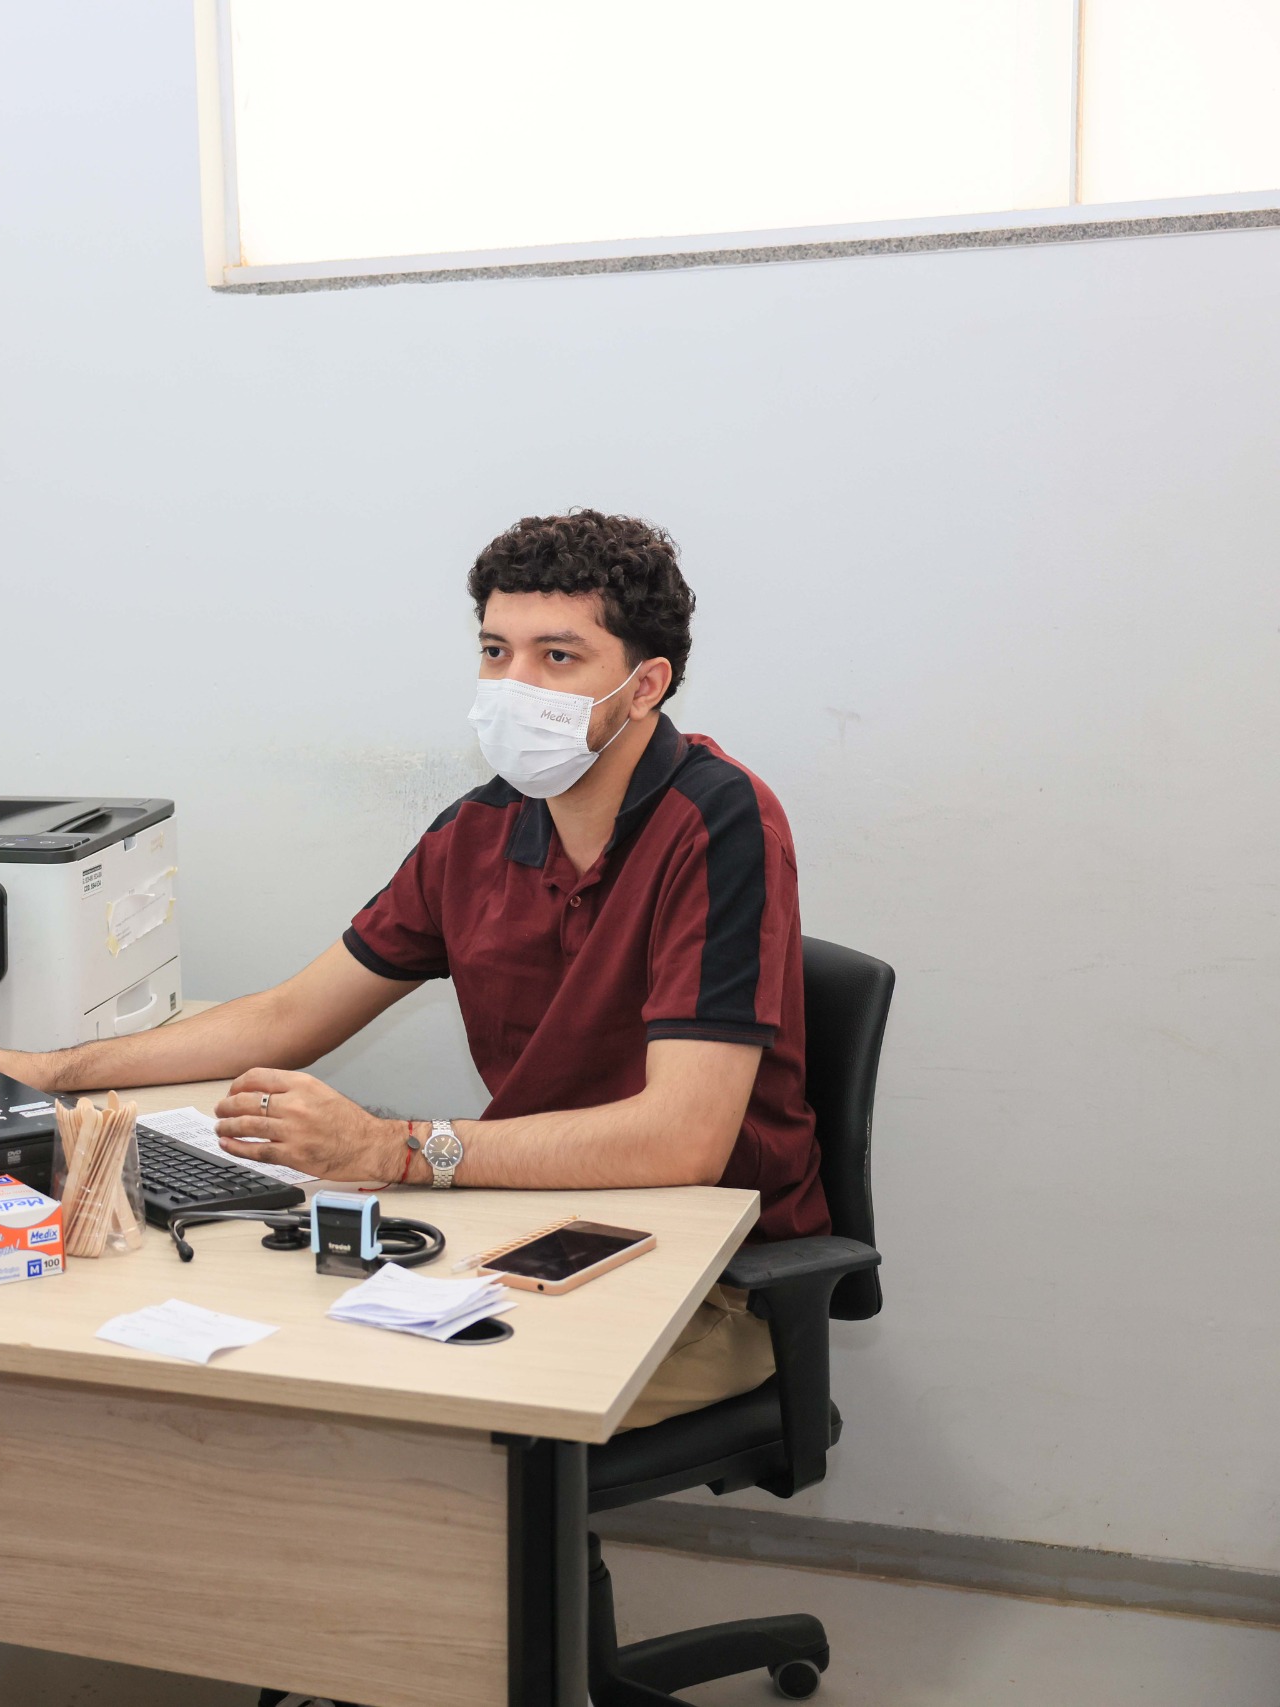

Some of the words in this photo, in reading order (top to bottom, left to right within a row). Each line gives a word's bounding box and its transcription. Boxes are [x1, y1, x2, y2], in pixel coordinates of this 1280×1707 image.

[540, 709, 571, 724] Medix
[30, 1228, 58, 1241] Medix
[30, 1264, 40, 1275] M
[44, 1258, 60, 1268] 100
